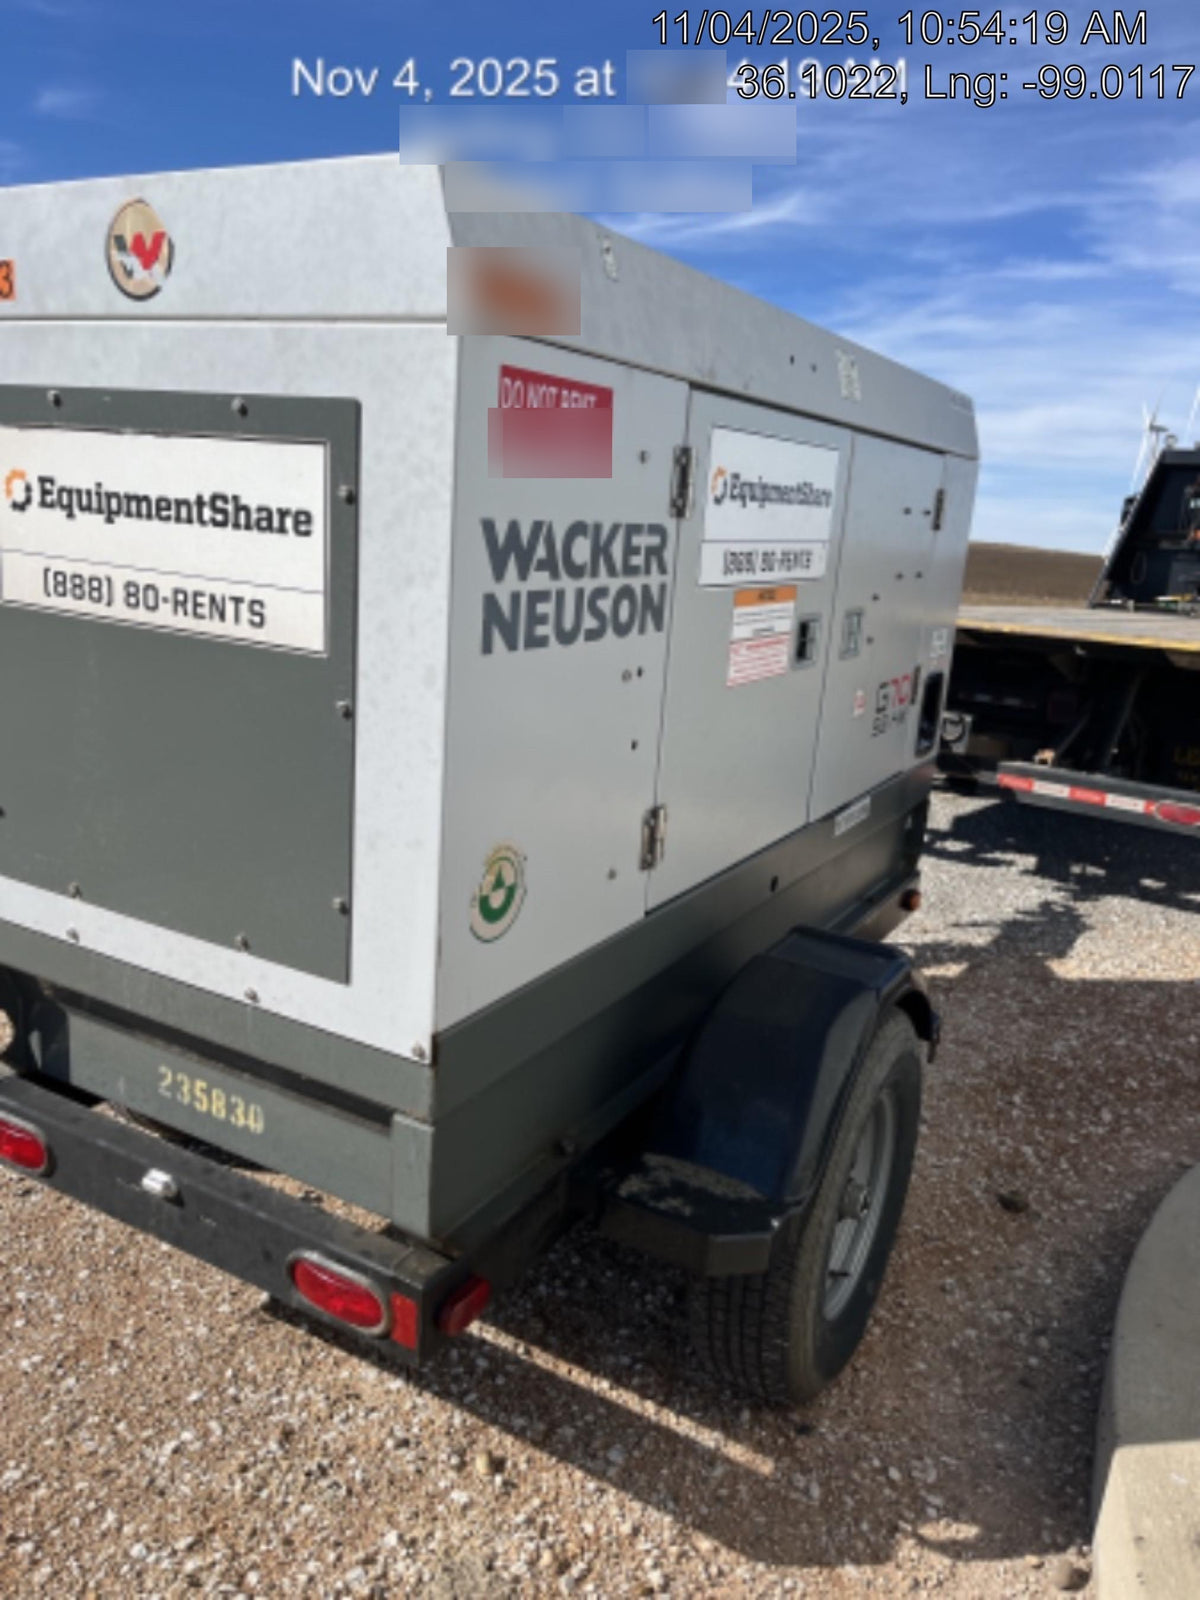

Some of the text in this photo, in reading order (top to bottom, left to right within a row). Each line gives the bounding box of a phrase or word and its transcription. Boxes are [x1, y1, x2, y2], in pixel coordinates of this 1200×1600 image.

[501, 377, 525, 408] DO
[527, 381, 558, 408] NOT
[37, 475, 313, 537] EquipmentShare
[480, 517, 668, 584] WACKER
[43, 567, 266, 629] (888) 80-RENTS
[480, 582, 667, 656] NEUSON
